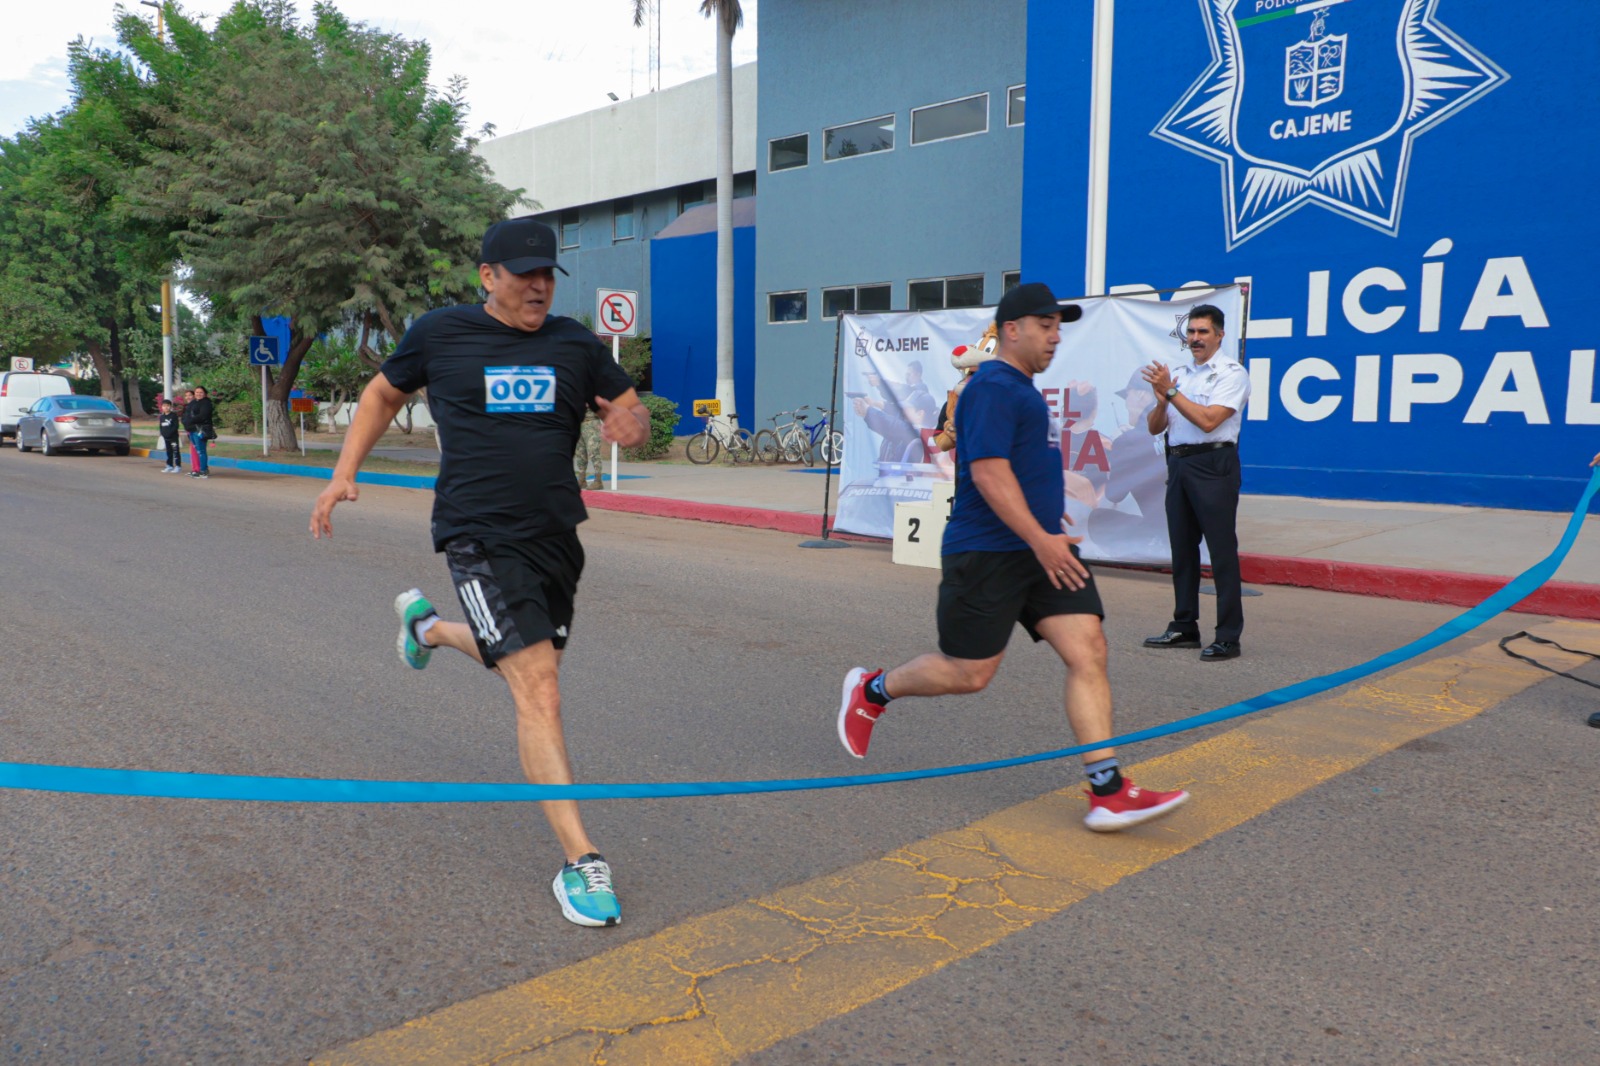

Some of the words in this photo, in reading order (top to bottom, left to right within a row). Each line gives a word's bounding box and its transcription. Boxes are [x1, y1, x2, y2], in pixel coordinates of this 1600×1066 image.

[1269, 109, 1352, 141] CAJEME
[1110, 238, 1550, 338] LICÍA
[875, 336, 929, 352] CAJEME
[491, 379, 550, 401] 007
[1246, 349, 1600, 425] ICIPAL
[907, 518, 921, 543] 2
